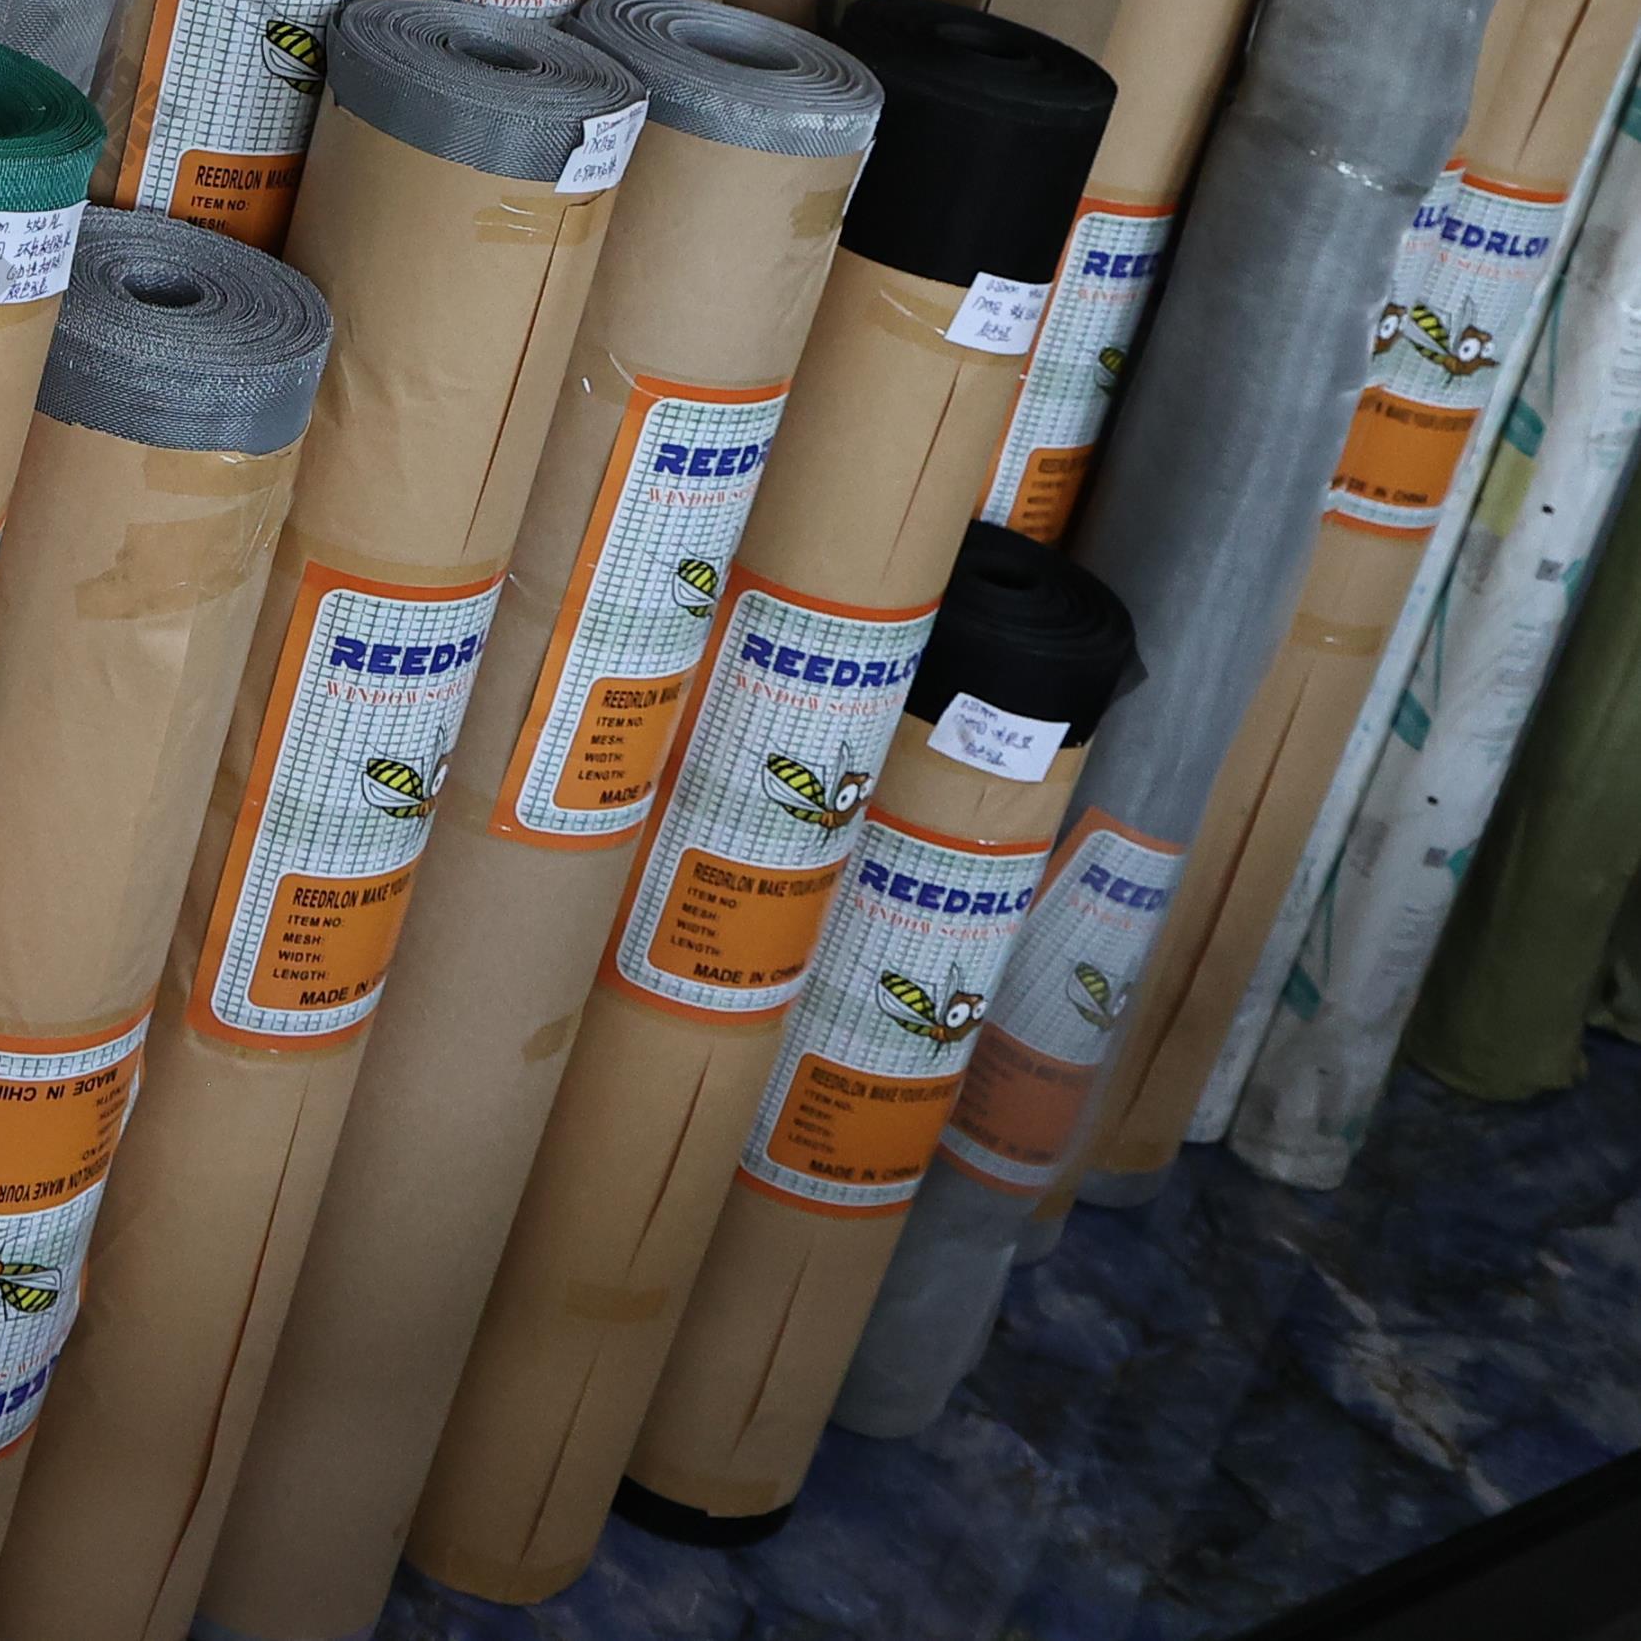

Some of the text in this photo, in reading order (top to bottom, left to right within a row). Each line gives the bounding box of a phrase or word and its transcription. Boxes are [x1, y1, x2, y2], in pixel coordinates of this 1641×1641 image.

[195, 165, 263, 190] REEDRLON
[190, 196, 224, 210] ITEM
[292, 887, 360, 909] REEDRLON
[360, 881, 391, 907] MAKE
[287, 914, 320, 927] ITEM
[299, 986, 350, 1006] MADE
[45, 1085, 66, 1100] IN
[72, 1067, 119, 1097] MADE
[31, 1177, 64, 1201] MAKE
